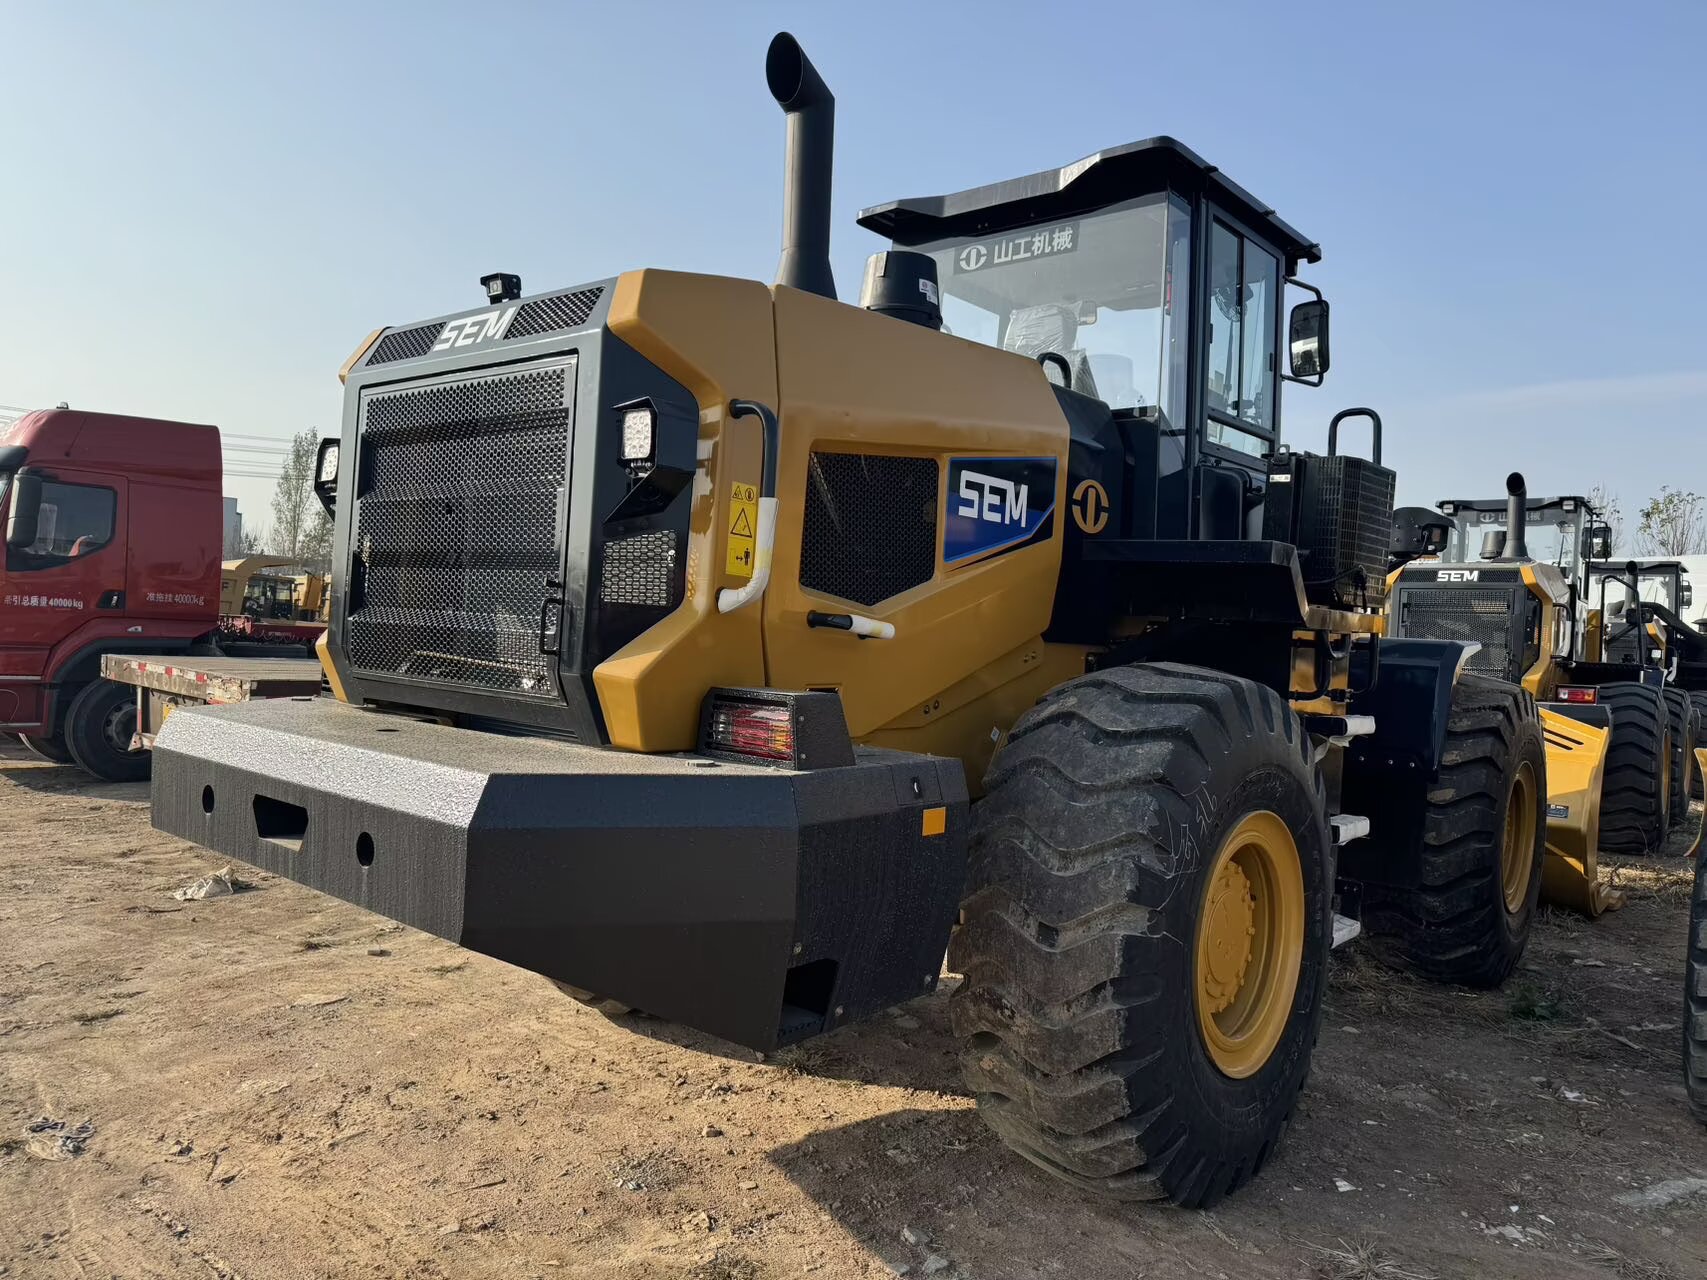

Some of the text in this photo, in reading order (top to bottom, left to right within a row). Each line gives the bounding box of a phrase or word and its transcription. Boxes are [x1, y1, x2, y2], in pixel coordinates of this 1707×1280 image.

[994, 227, 1073, 264] 山工机械
[433, 306, 516, 351] SEM
[958, 469, 1028, 528] SEM
[1437, 570, 1479, 581] SEM
